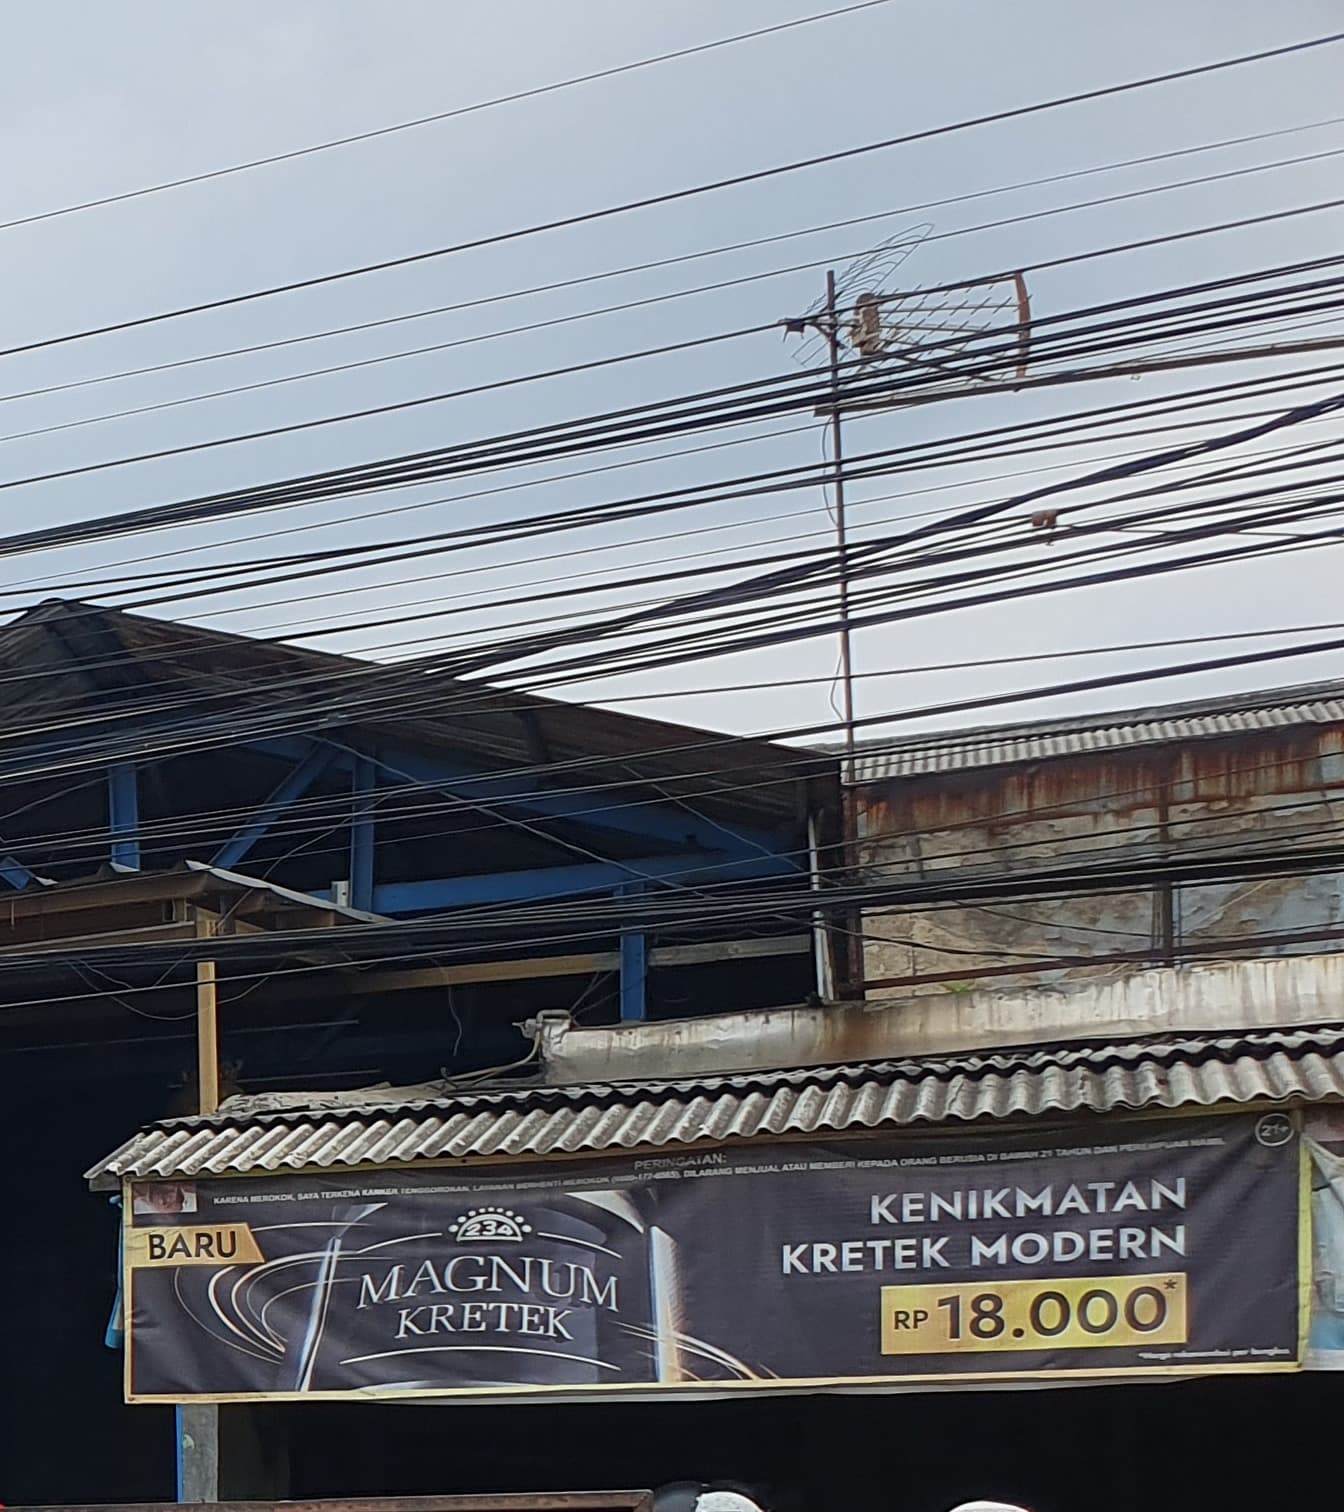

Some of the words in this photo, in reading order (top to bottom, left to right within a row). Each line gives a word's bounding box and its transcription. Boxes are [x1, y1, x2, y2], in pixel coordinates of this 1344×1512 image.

[782, 1162, 807, 1172] ATAU
[857, 1159, 899, 1169] KEPADA
[900, 1157, 937, 1167] ORANG
[869, 1177, 1187, 1226] KENIKMATAN
[148, 1230, 237, 1260] BARU
[465, 1220, 513, 1237] 234
[781, 1237, 951, 1275] KRETEK
[970, 1224, 1187, 1268] MODERN
[356, 1254, 620, 1313] MAGNUM
[393, 1302, 575, 1341] KRETEK
[893, 1308, 929, 1331] RP
